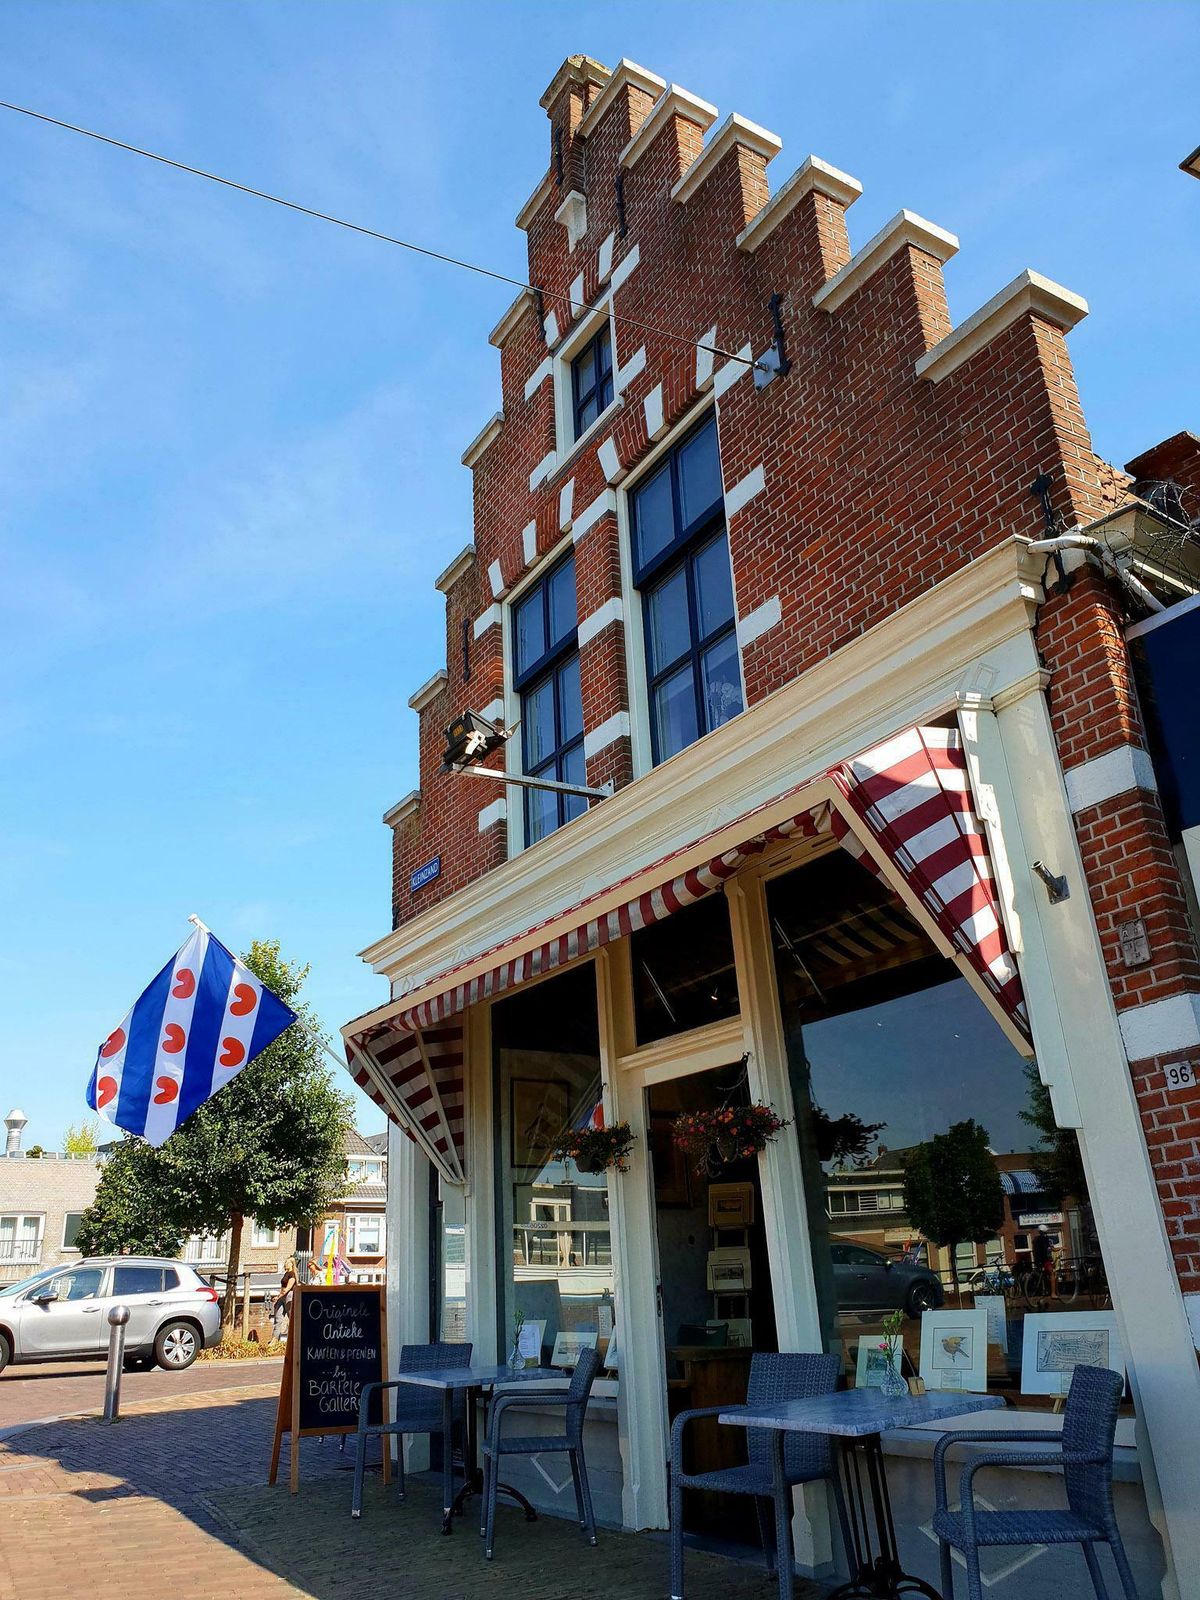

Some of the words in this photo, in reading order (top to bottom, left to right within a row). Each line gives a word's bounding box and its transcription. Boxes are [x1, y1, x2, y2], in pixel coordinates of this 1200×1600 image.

[1169, 1066, 1190, 1085] 96
[308, 1299, 369, 1321] Originele
[323, 1321, 364, 1340] Antieke
